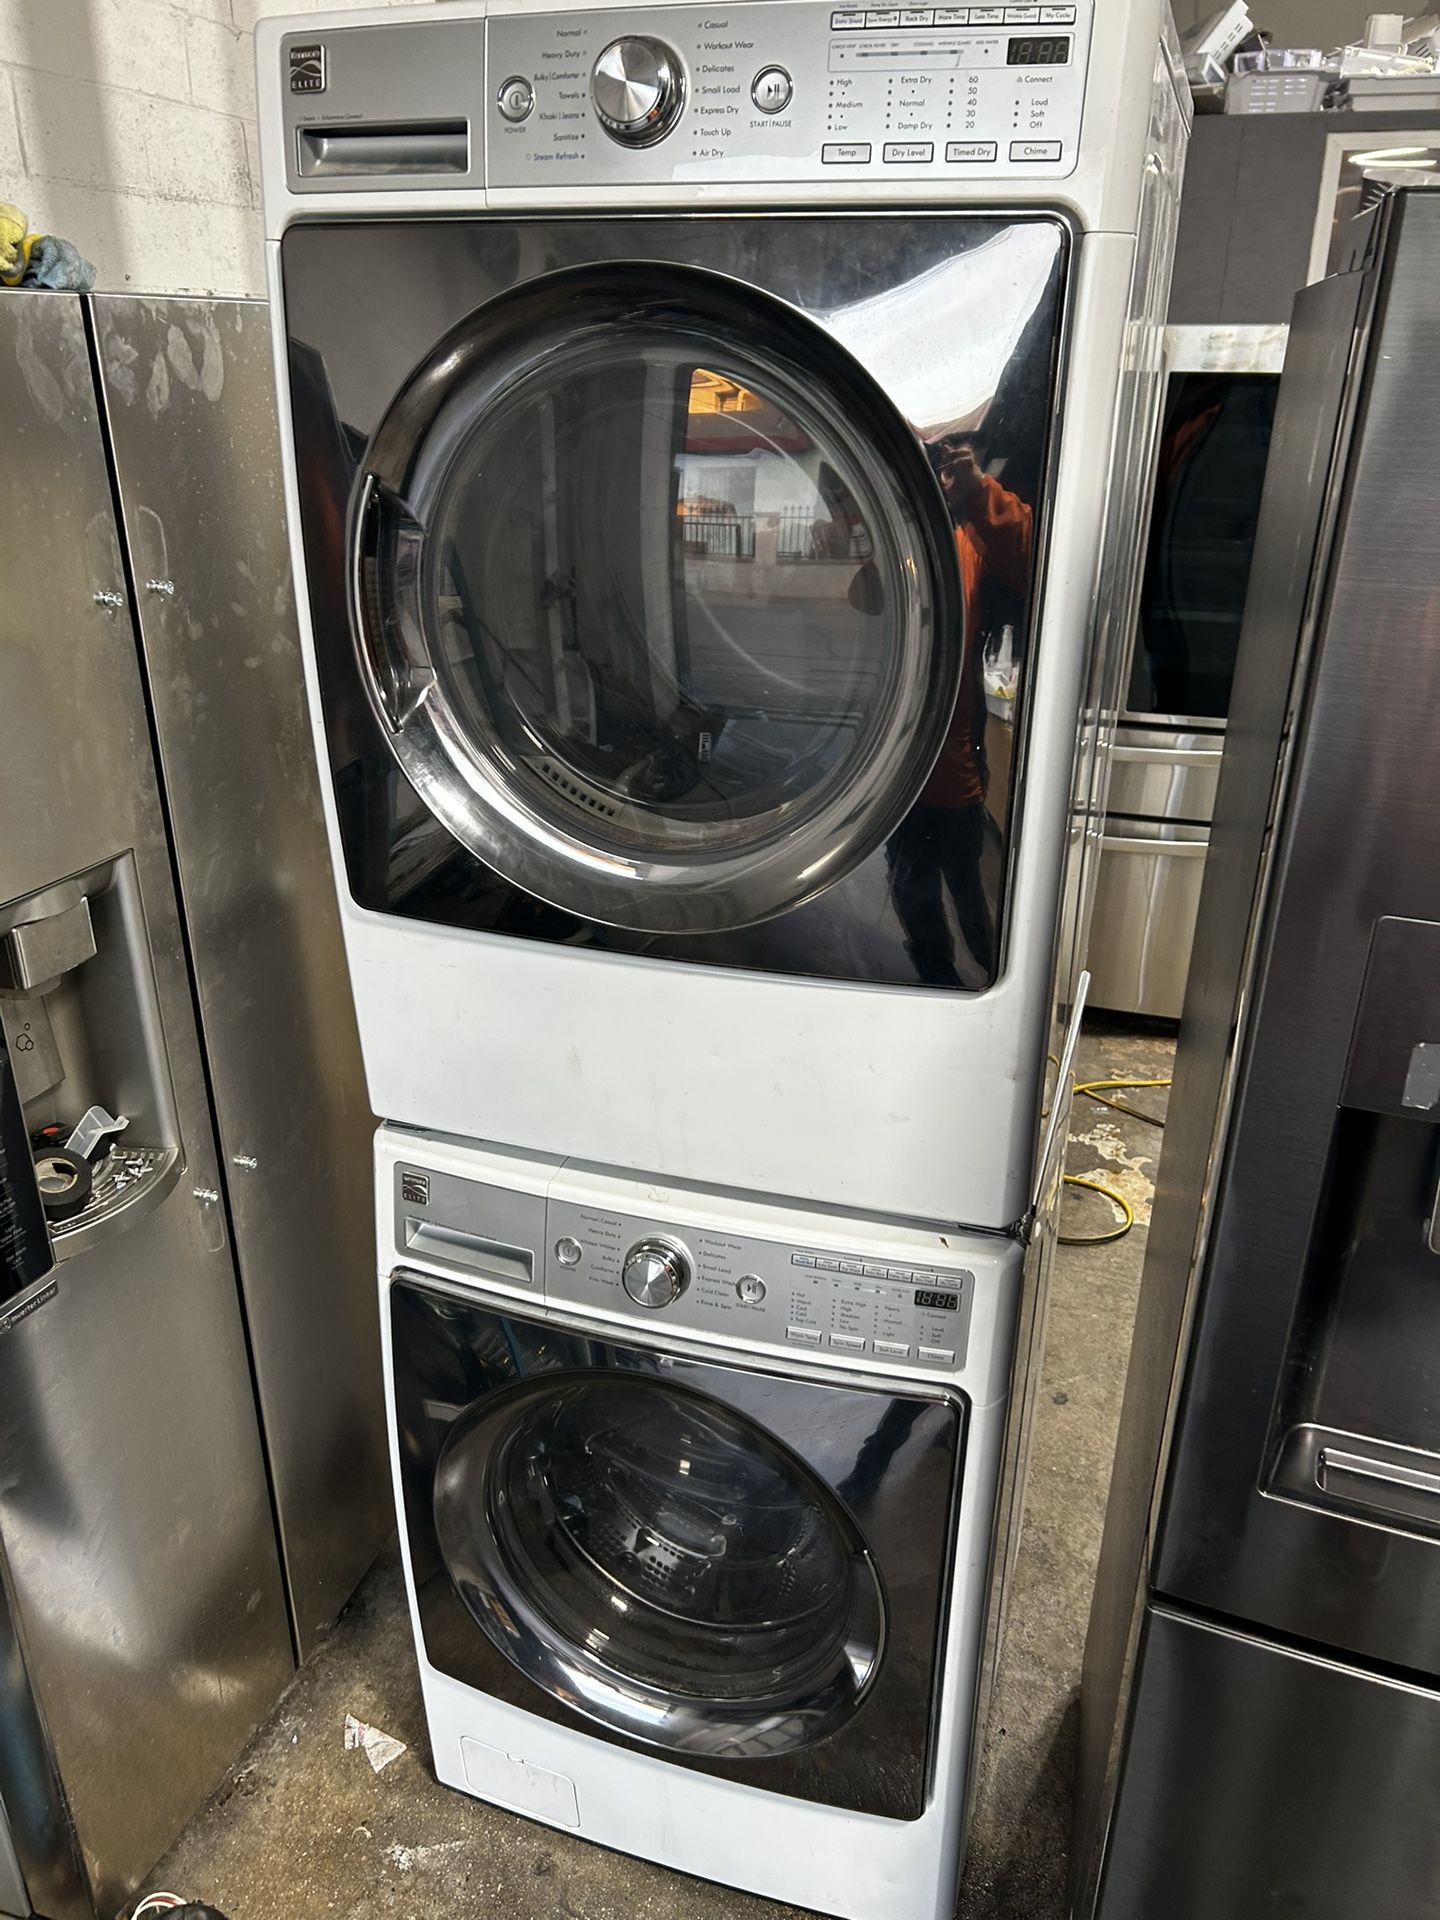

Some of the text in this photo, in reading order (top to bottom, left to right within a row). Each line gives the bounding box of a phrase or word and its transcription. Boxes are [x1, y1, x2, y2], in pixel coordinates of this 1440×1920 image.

[919, 14, 928, 22] Dry
[704, 20, 728, 29] Casual
[556, 28, 582, 38] Normal
[704, 40, 754, 50] Workout Wear
[565, 50, 580, 58] Duty
[702, 64, 734, 73] Delicates
[292, 78, 320, 88] ELITE
[837, 79, 852, 88] High
[920, 76, 932, 84] Dry
[968, 76, 978, 84] 60
[1024, 75, 1053, 84] Connect
[702, 86, 740, 94] Small Load
[968, 86, 978, 94] 50
[559, 91, 580, 100] Towels
[836, 100, 863, 108] Medium
[967, 98, 978, 106] 40
[700, 106, 740, 115] Express Dry
[966, 110, 976, 118] 30
[1030, 110, 1045, 118] Soft
[898, 122, 933, 130] Damp Dry
[553, 133, 578, 142] Sanitize
[700, 128, 732, 138] Touch Up
[700, 148, 724, 157] Air Dry
[838, 148, 856, 157] Temp
[892, 148, 906, 157] Dry
[954, 148, 991, 156] Timed Dry
[1024, 146, 1048, 155] Chime
[534, 152, 579, 161] Steam Refresh
[704, 1240, 726, 1248] Workout
[703, 1250, 726, 1260] Delicates
[10, 1300, 37, 1322] Inverter
